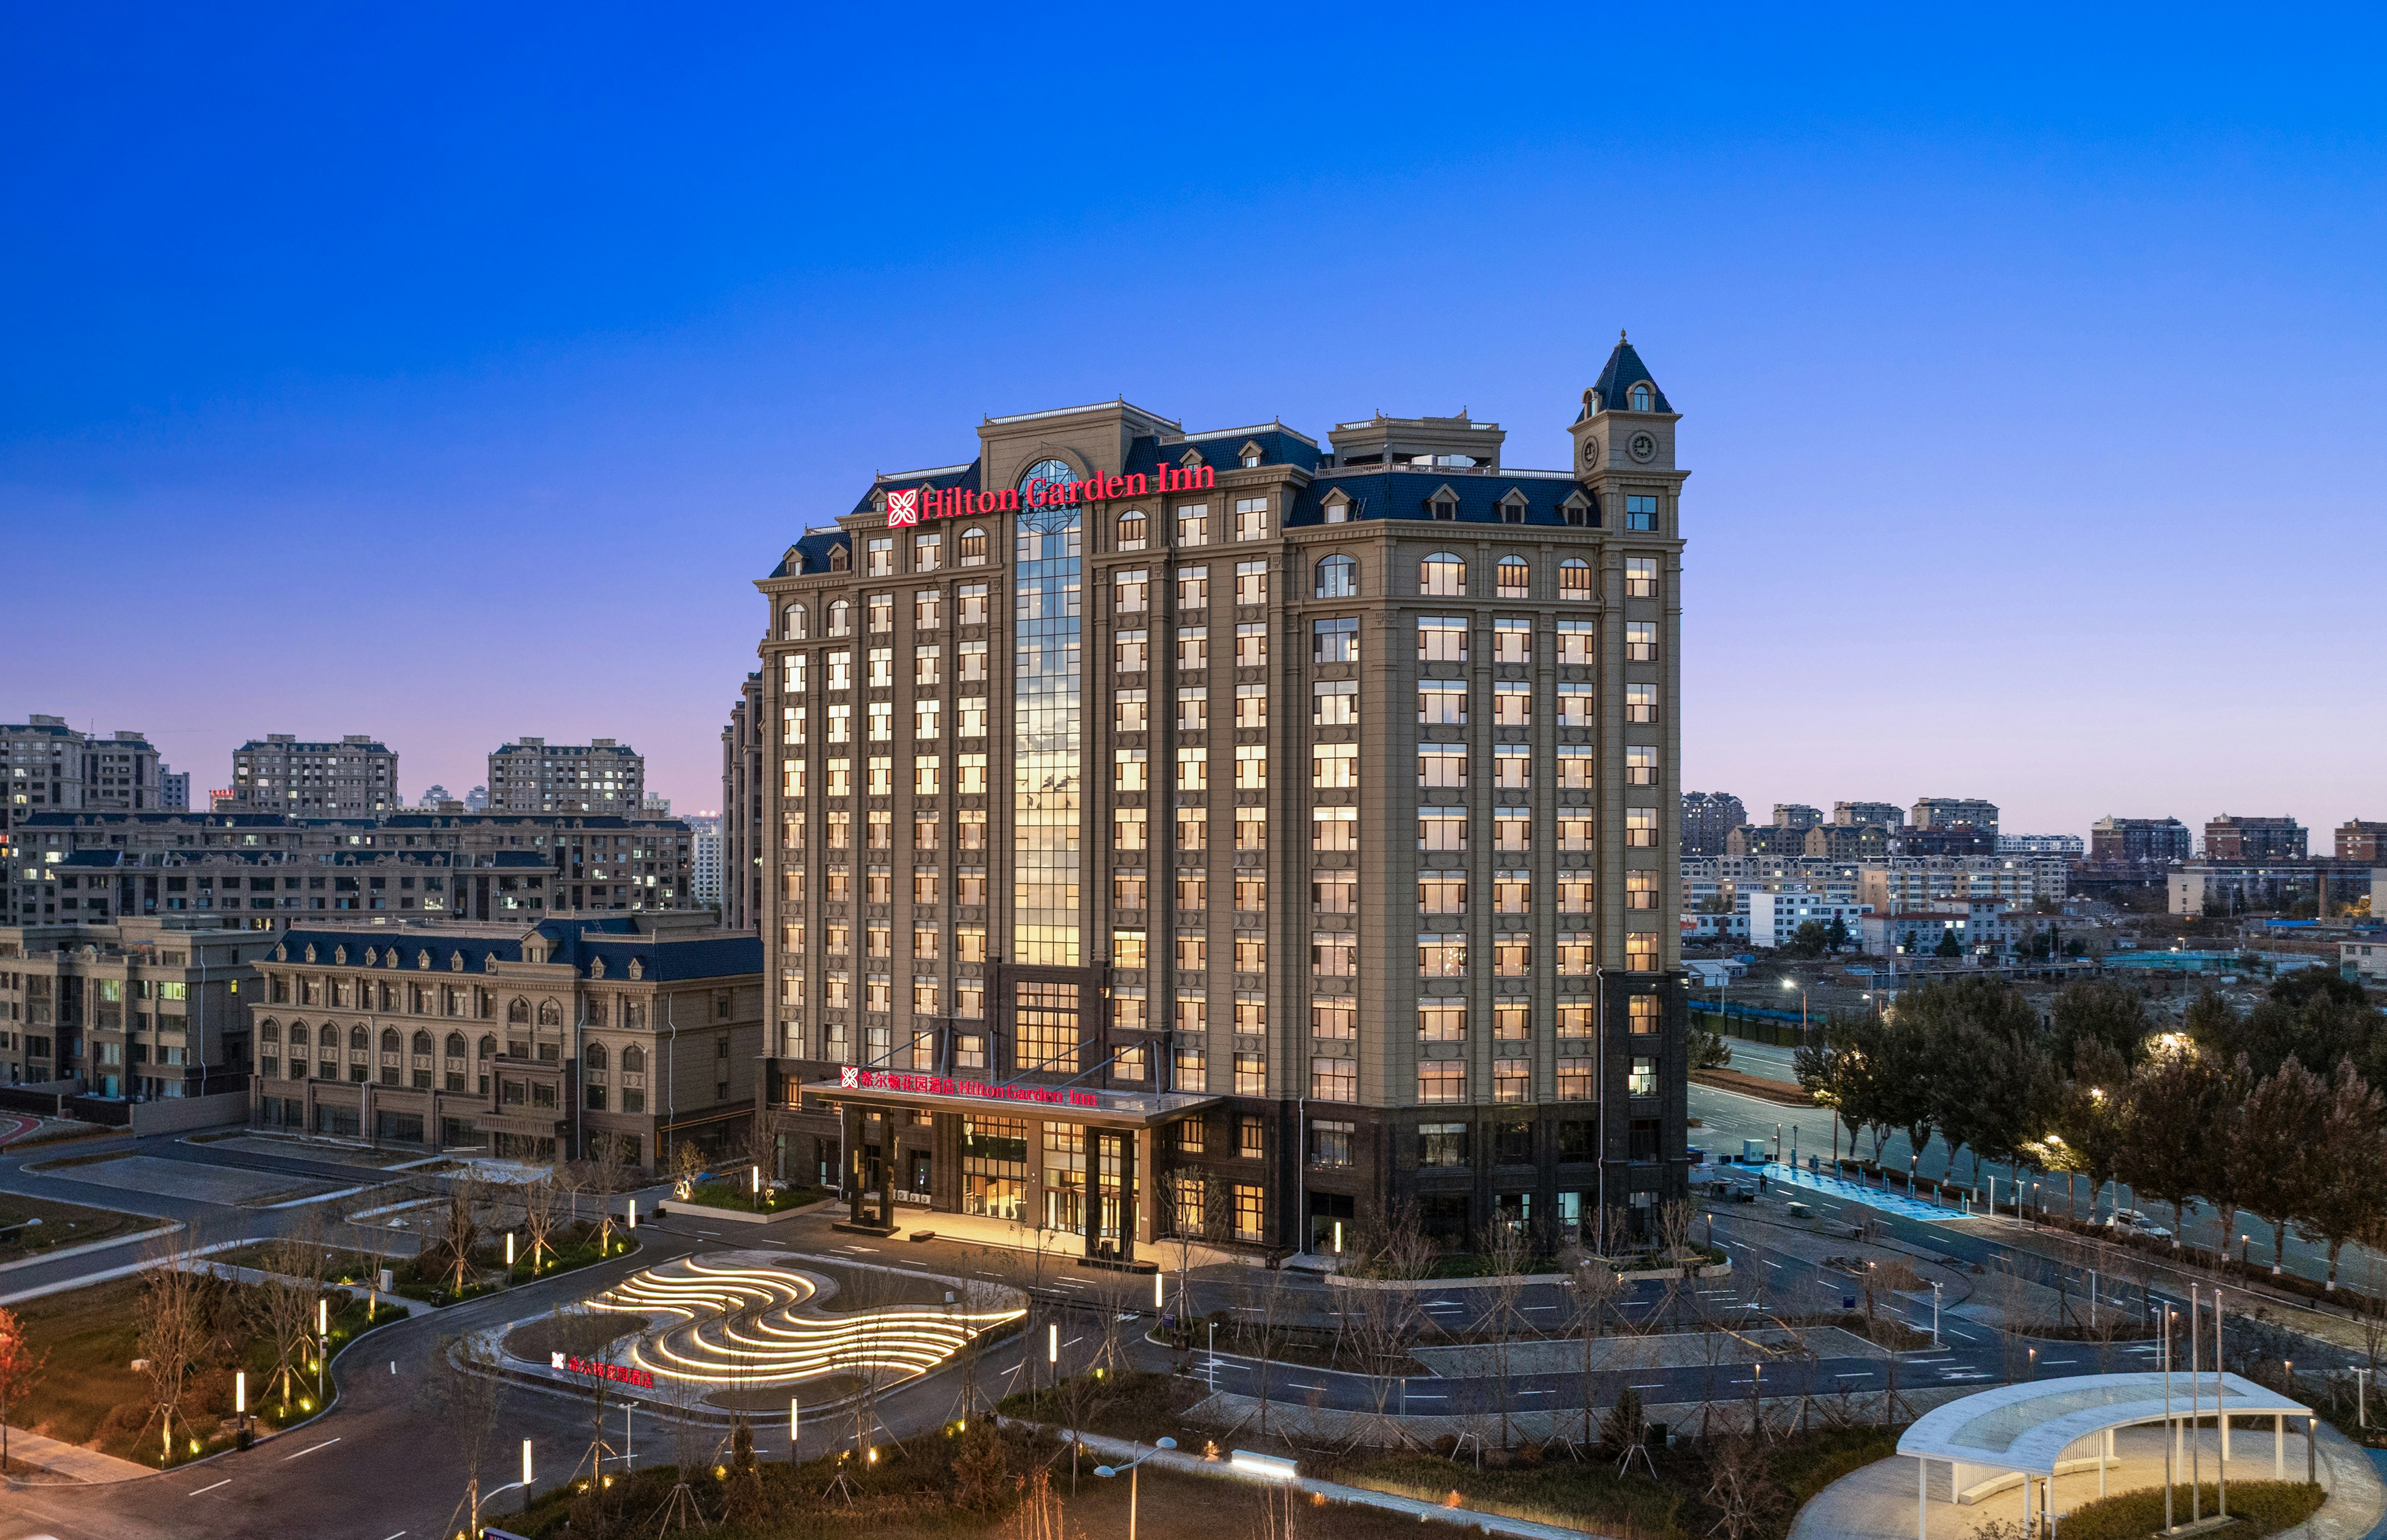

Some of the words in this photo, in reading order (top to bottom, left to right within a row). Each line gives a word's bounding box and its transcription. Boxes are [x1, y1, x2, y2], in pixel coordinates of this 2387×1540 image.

[922, 486, 1020, 520] Hilton
[1026, 469, 1148, 508] Garden
[1156, 462, 1215, 493] Inn
[860, 1070, 955, 1095] 希尔顿花园酒店
[959, 1079, 1004, 1099] Hilton
[1006, 1084, 1062, 1103] Garden
[1069, 1089, 1097, 1106] Inn
[567, 1356, 654, 1389] 希尔顿花园酒店
